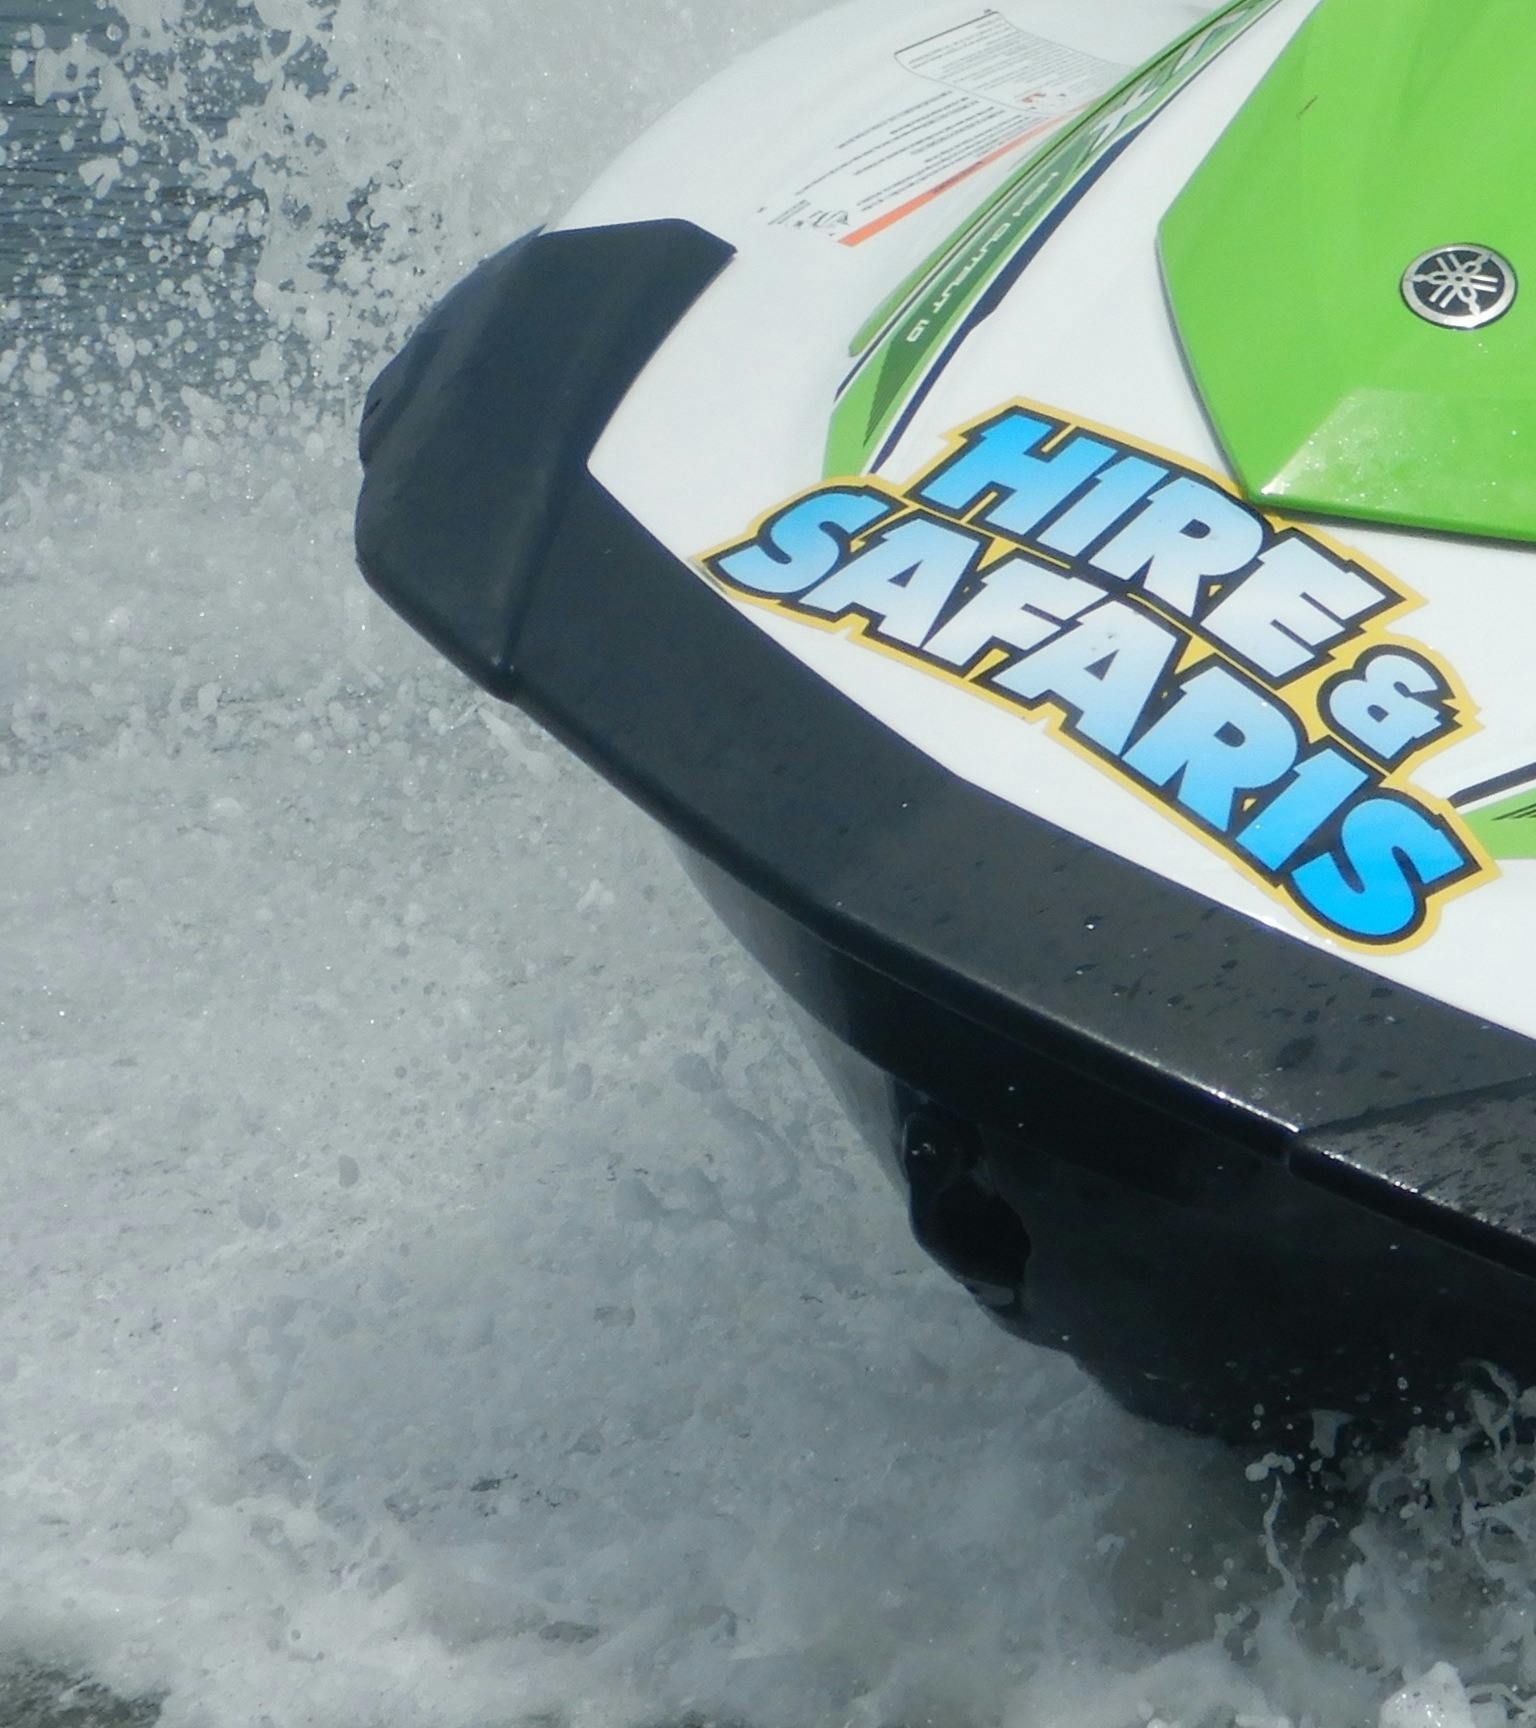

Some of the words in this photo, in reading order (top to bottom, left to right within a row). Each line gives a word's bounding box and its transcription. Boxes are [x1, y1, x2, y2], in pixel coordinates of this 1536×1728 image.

[706, 485, 1480, 946] SAFARIS
[920, 406, 1390, 684] HIRE
[1320, 642, 1460, 769] &
